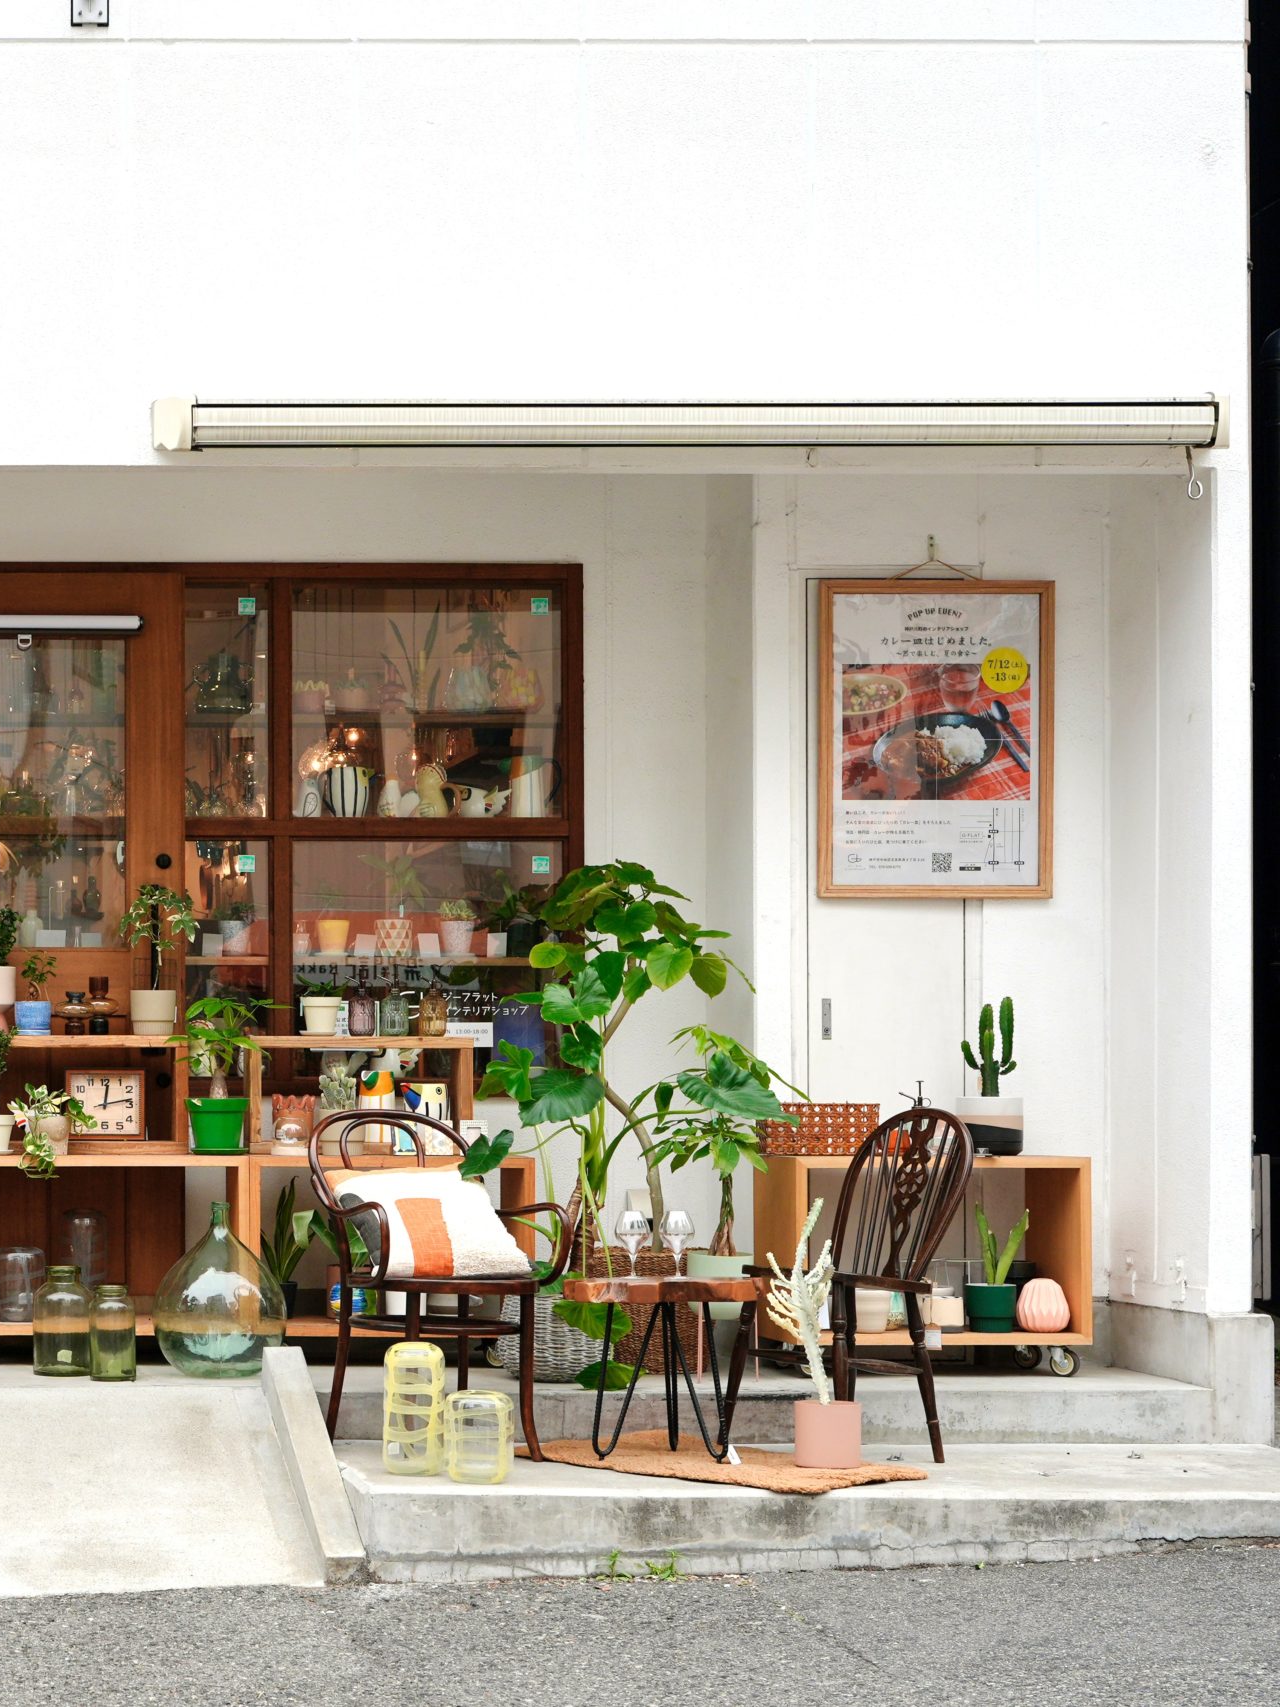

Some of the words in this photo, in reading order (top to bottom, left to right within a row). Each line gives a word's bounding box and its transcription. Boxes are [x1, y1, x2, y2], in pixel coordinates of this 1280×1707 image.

[907, 609, 923, 621] POP
[925, 607, 936, 615] UP
[881, 636, 992, 647] カレー皿はじめました。
[442, 992, 498, 1002] ジーフラット
[446, 1005, 529, 1016] インテリアショップ
[87, 1079, 94, 1087] 11
[100, 1079, 110, 1087] 12
[118, 1079, 122, 1087] 1
[76, 1085, 86, 1094] 10
[125, 1085, 134, 1094] 2
[125, 1100, 134, 1109] 3
[125, 1115, 133, 1124] 4
[101, 1121, 109, 1130] 6
[116, 1121, 124, 1130] 5
